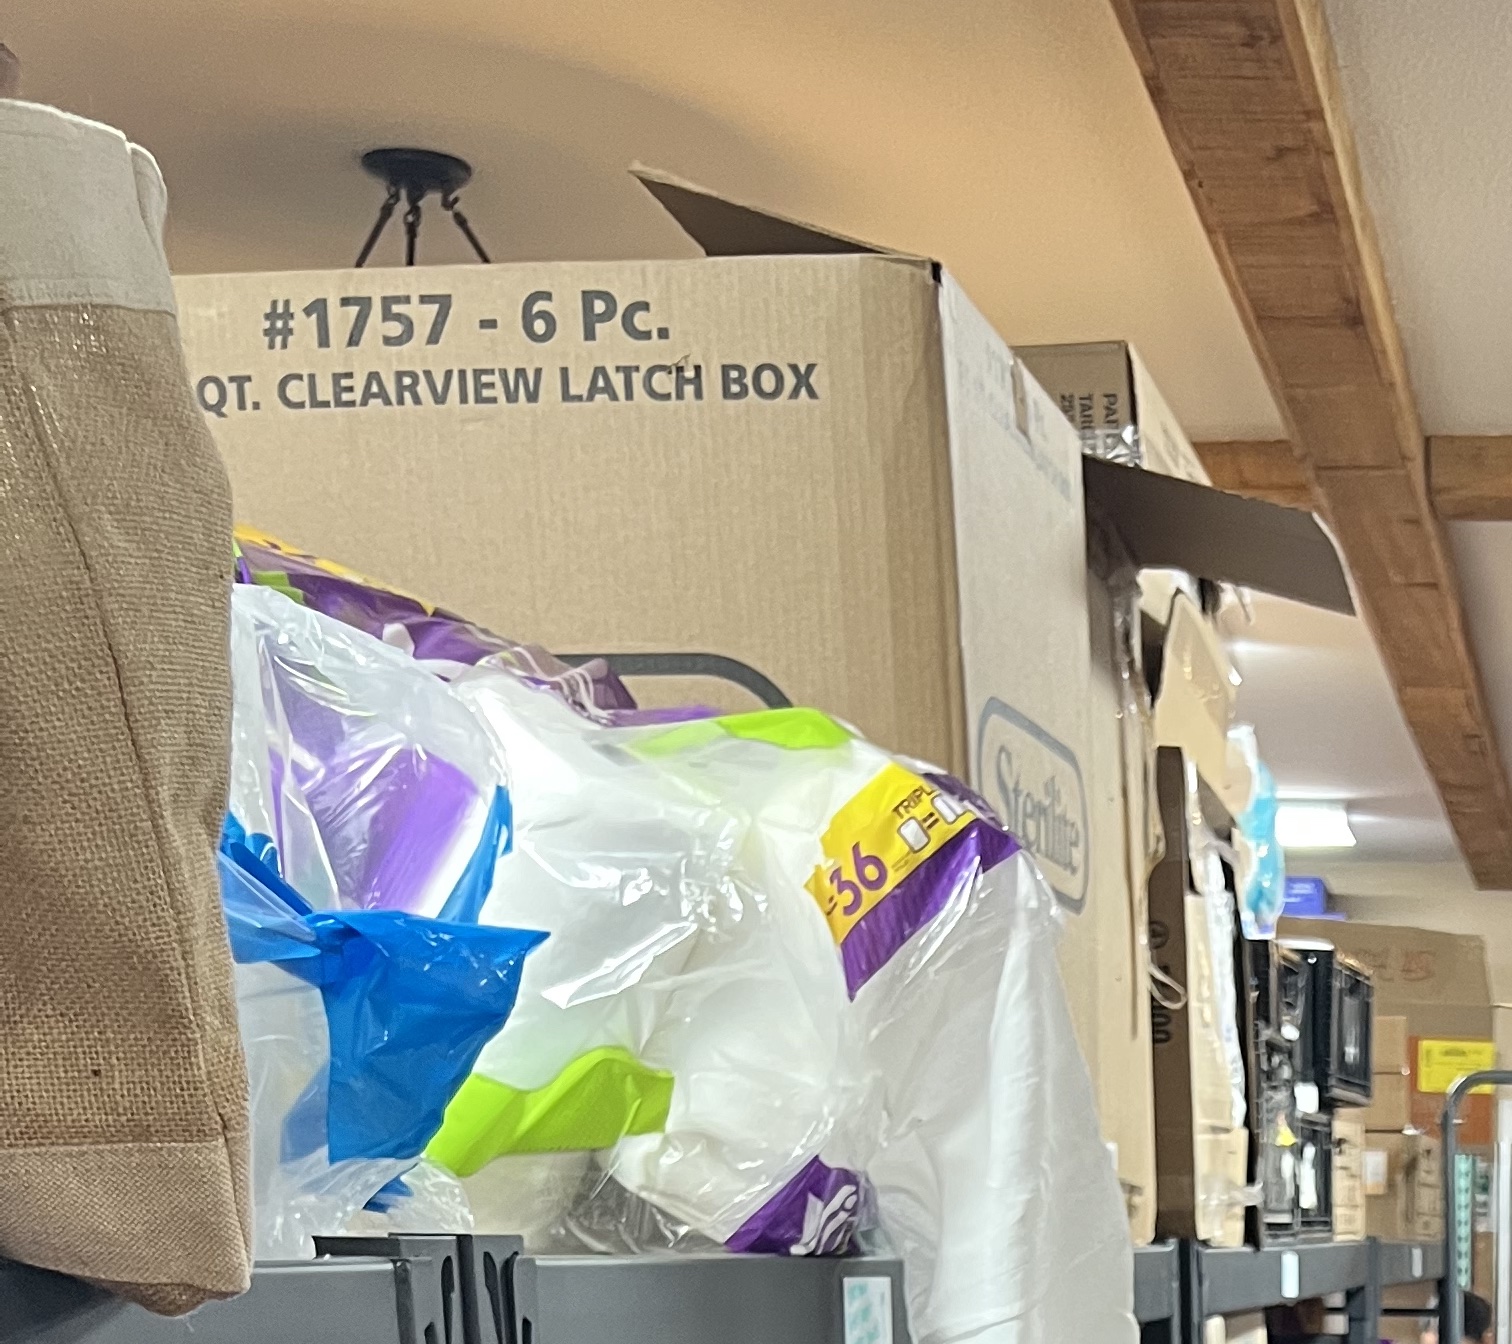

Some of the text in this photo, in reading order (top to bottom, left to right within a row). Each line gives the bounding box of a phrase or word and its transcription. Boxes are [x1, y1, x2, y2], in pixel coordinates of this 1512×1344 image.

[262, 294, 453, 350] #1757
[521, 290, 558, 343] 6
[580, 289, 670, 342] Pc.
[196, 362, 820, 418] QT. CLEARVIEW LATCH BOX
[891, 784, 941, 819] TRIPL
